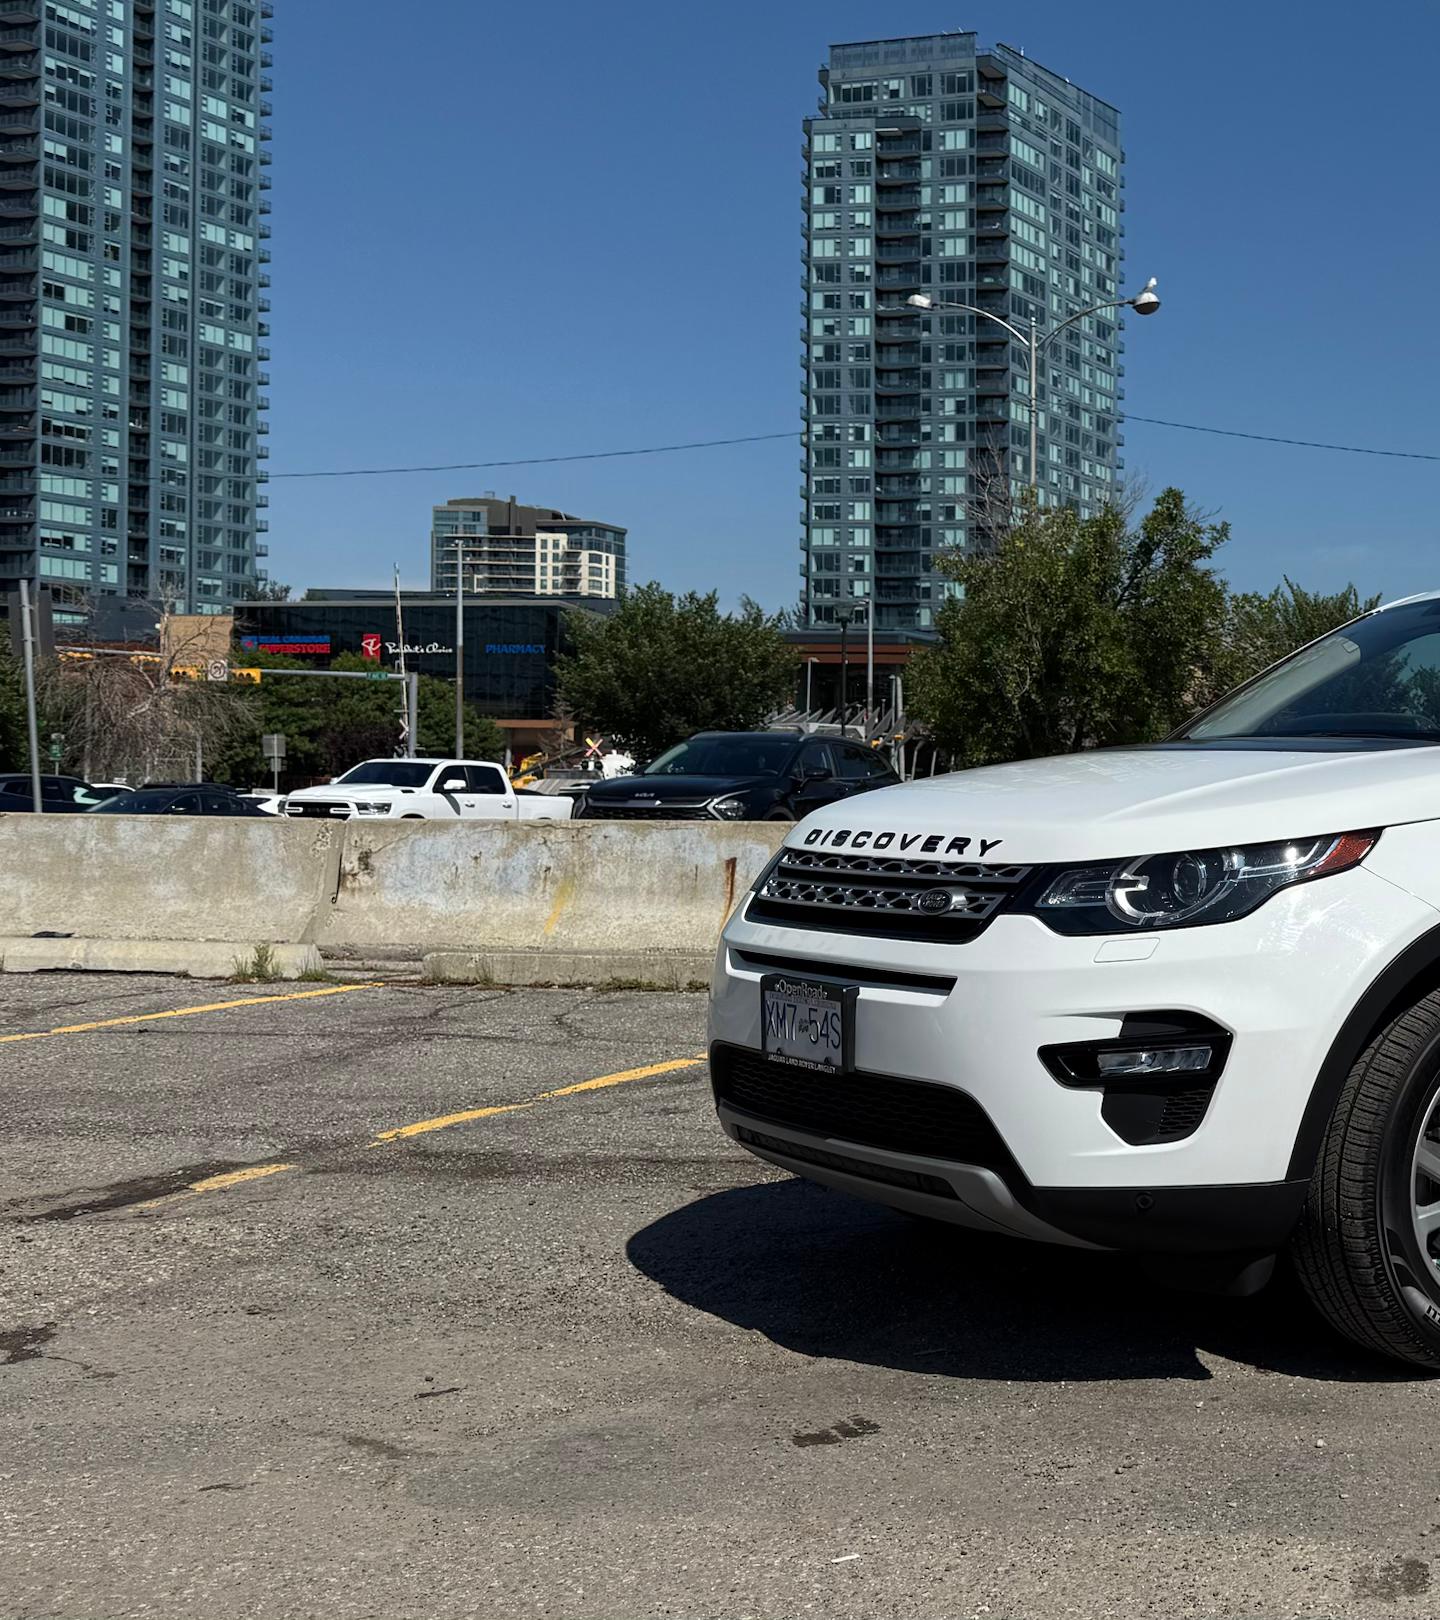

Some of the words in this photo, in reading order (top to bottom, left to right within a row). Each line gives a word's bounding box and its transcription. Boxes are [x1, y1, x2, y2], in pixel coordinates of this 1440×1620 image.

[425, 641, 453, 654] Choice
[485, 644, 546, 654] PHARMACY
[804, 829, 1004, 857] DISCOVERY
[778, 979, 823, 999] OpenRoad
[765, 999, 798, 1041] XM7
[808, 1007, 841, 1049] 54S
[767, 1054, 786, 1064] JAGUAR
[785, 1057, 799, 1066] LAND
[814, 1063, 836, 1074] LANGLEY
